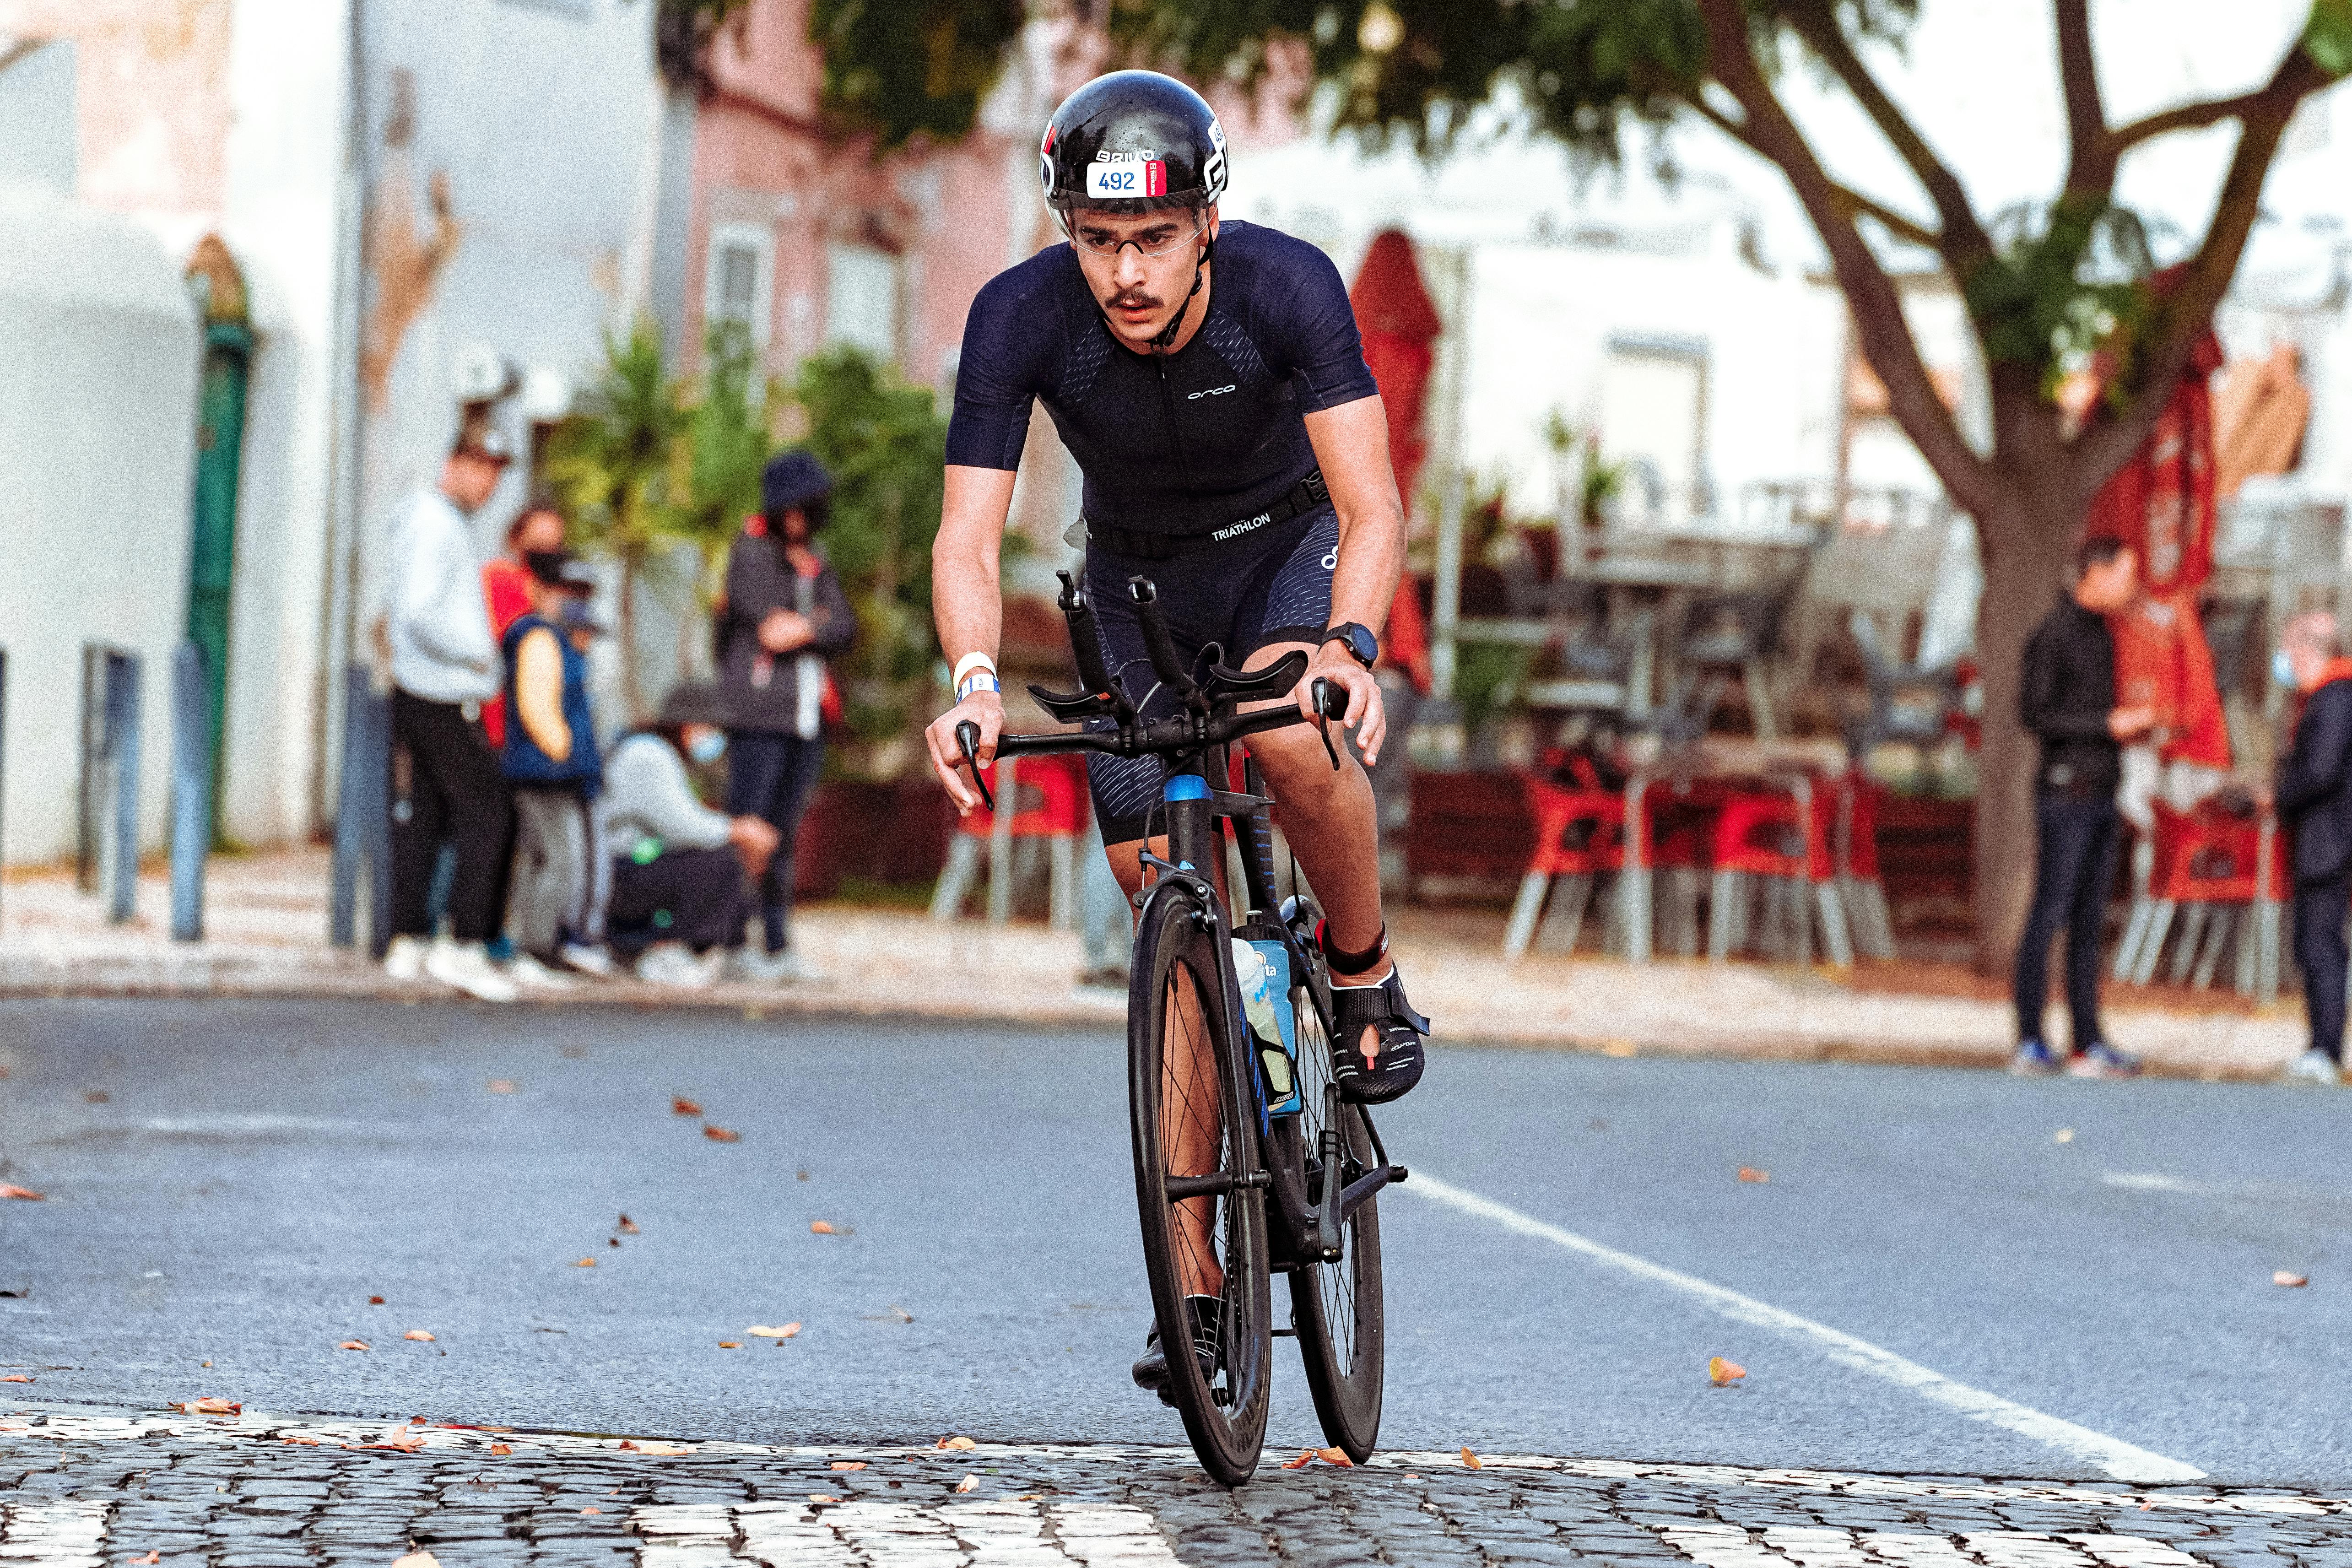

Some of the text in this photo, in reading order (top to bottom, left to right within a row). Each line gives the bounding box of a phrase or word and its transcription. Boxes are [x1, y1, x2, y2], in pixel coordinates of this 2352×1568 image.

[1096, 150, 1155, 162] BRIKO
[1099, 172, 1135, 190] 492
[1188, 385, 1236, 399] orca
[1211, 513, 1271, 541] TRIATHLON
